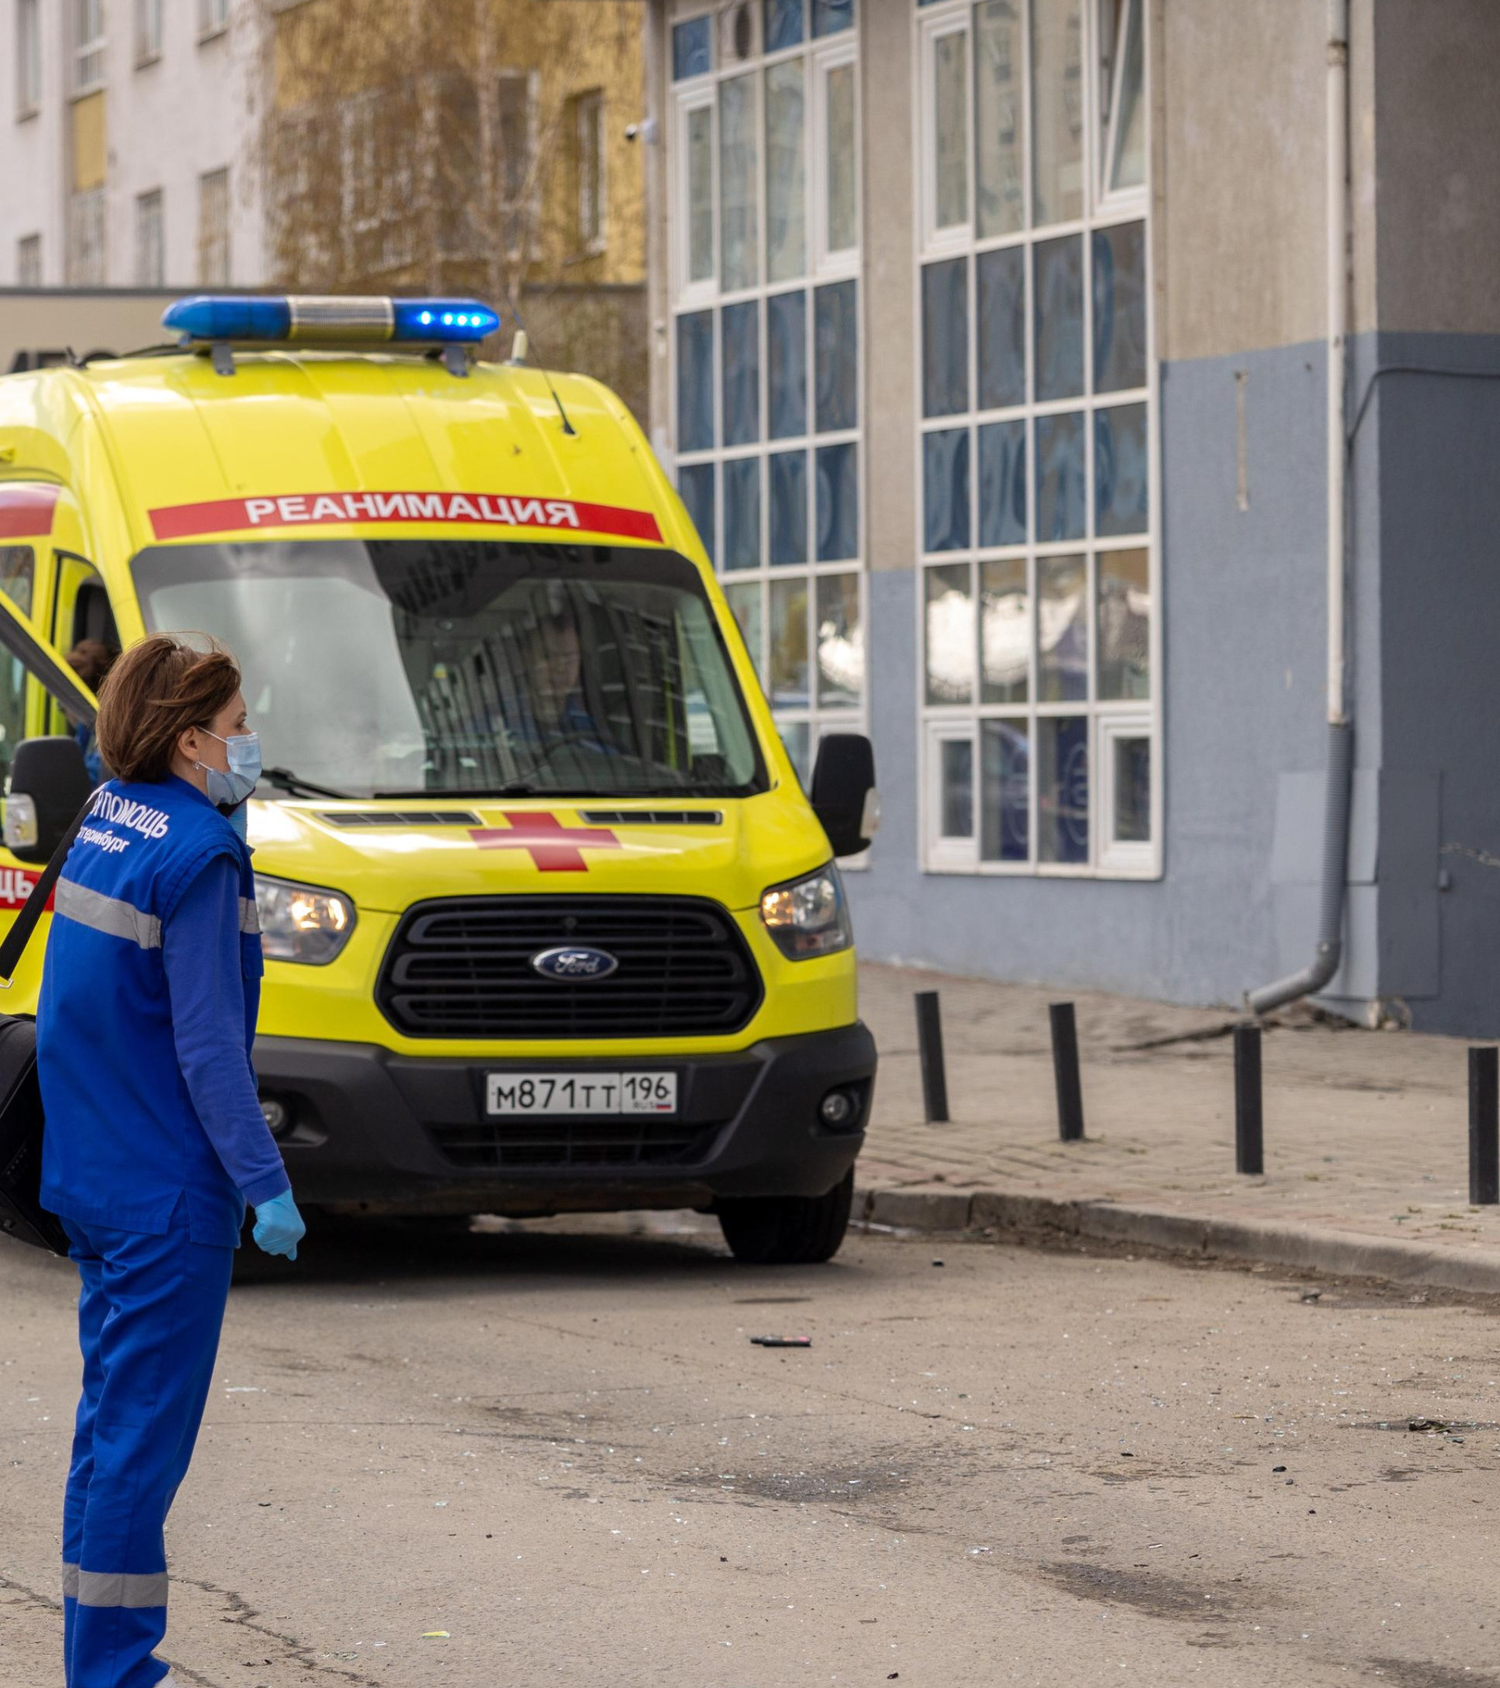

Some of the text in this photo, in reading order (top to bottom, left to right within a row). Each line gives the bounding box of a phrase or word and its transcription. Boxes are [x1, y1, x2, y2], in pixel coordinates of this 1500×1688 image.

[246, 494, 580, 527] РЕАНИМАЦИЯ
[100, 791, 170, 839] ПОМОЩЬ
[554, 953, 601, 973] Ford
[497, 1077, 669, 1109] М871ТТ 196
